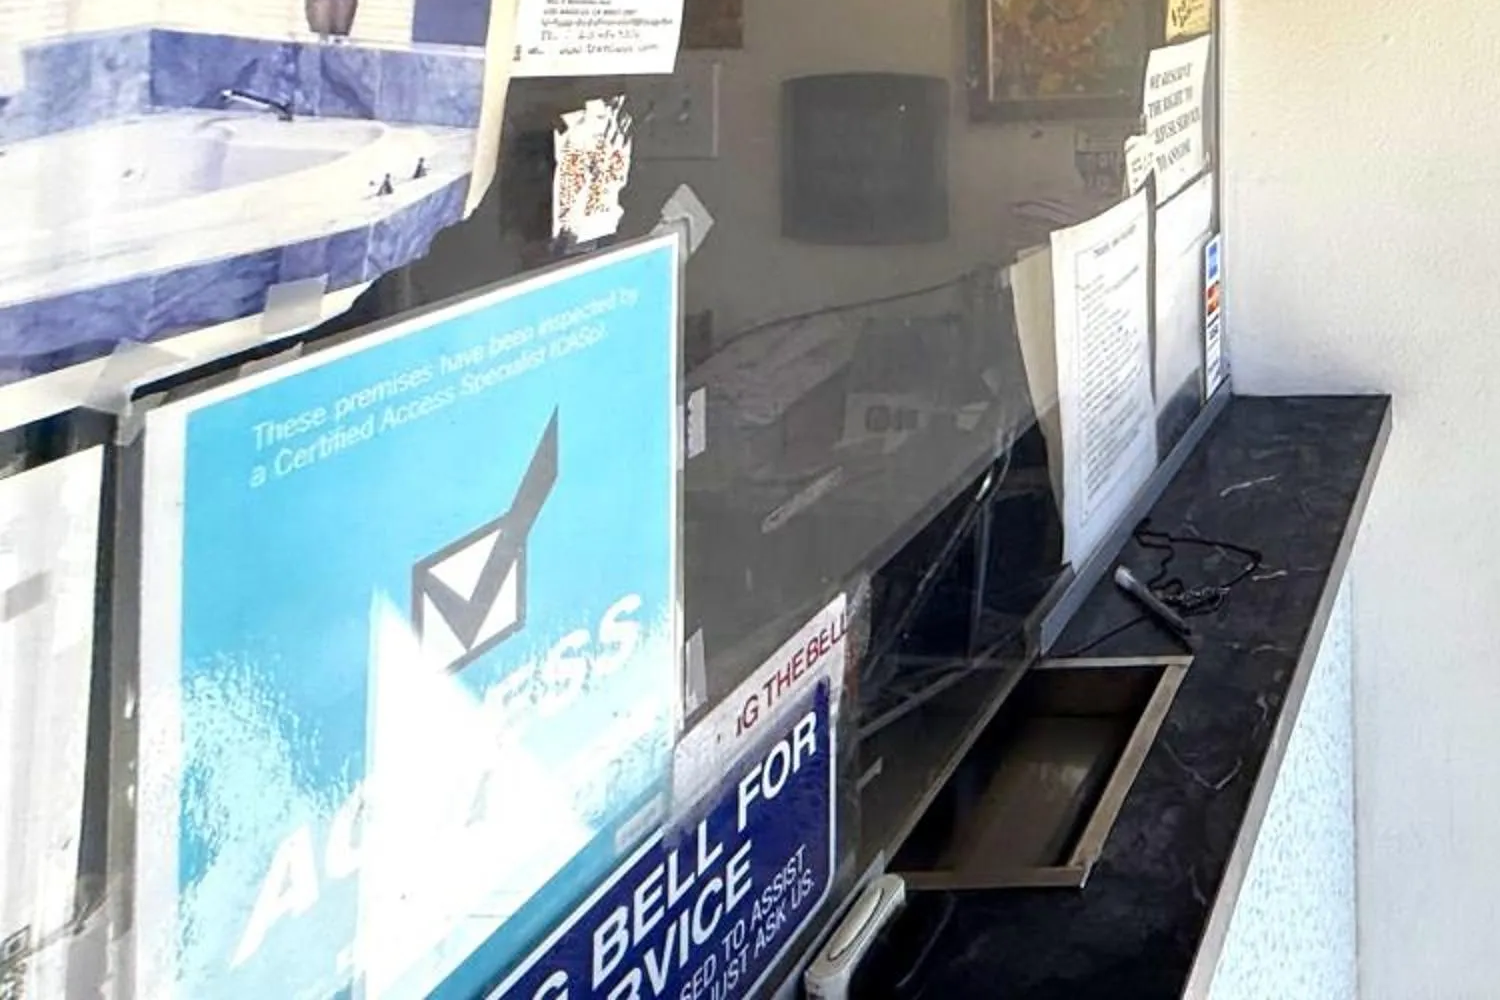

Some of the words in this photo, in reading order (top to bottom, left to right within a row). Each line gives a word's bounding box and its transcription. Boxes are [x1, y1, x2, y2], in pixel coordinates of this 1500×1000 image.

[250, 465, 267, 488] a
[274, 413, 375, 476] Certified
[379, 385, 457, 432] Access
[459, 347, 546, 395] Specialist
[253, 406, 327, 451] These
[334, 364, 433, 422] premises
[440, 345, 485, 376] have
[488, 326, 535, 356] been
[538, 290, 617, 337] inspected
[618, 286, 639, 308] by
[592, 818, 724, 992] BELL
[737, 711, 817, 832] FOR
[722, 918, 746, 962] TO
[750, 844, 806, 932] ASSIST
[753, 898, 787, 960] ASK
